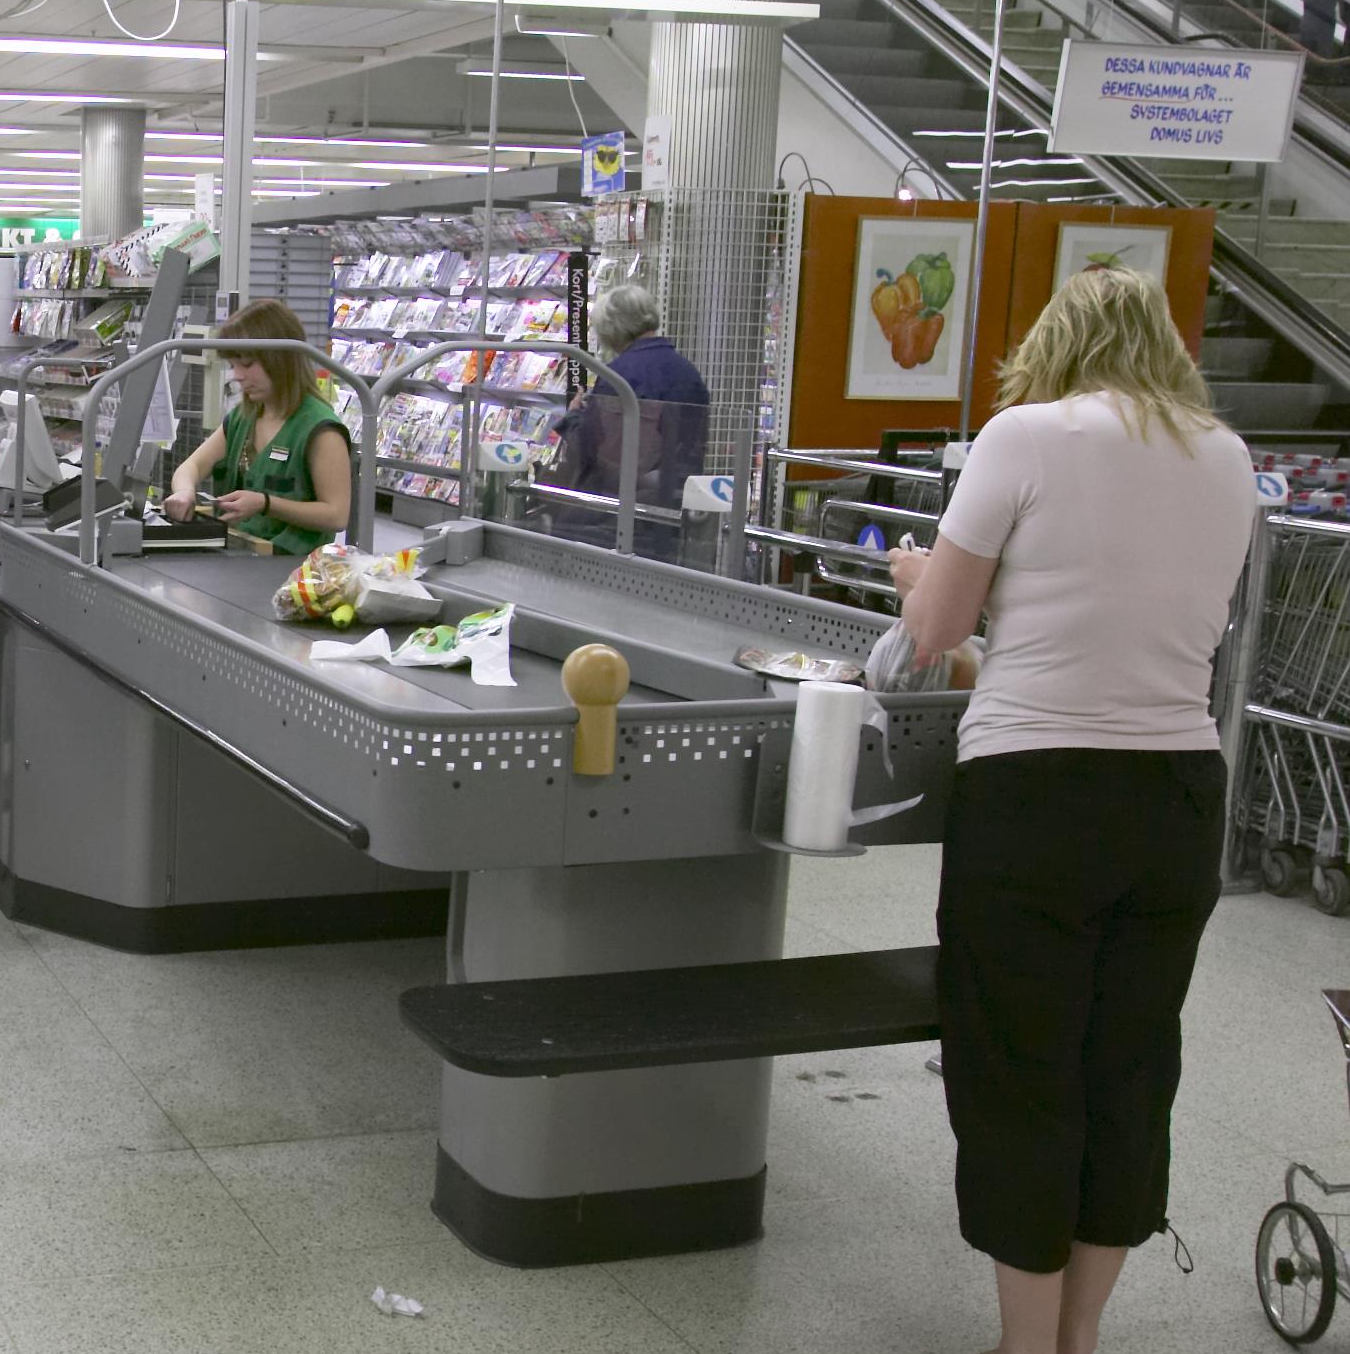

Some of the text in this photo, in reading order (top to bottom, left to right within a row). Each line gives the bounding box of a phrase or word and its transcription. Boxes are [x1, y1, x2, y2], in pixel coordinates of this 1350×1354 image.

[1105, 57, 1145, 74] DESSA
[1149, 59, 1231, 78] KUNDVAGNAR
[1102, 81, 1190, 100] GEMENSAMMA
[1130, 104, 1234, 124] SYSTEMBOLAGET
[1150, 127, 1223, 145] DOMUS LIVS
